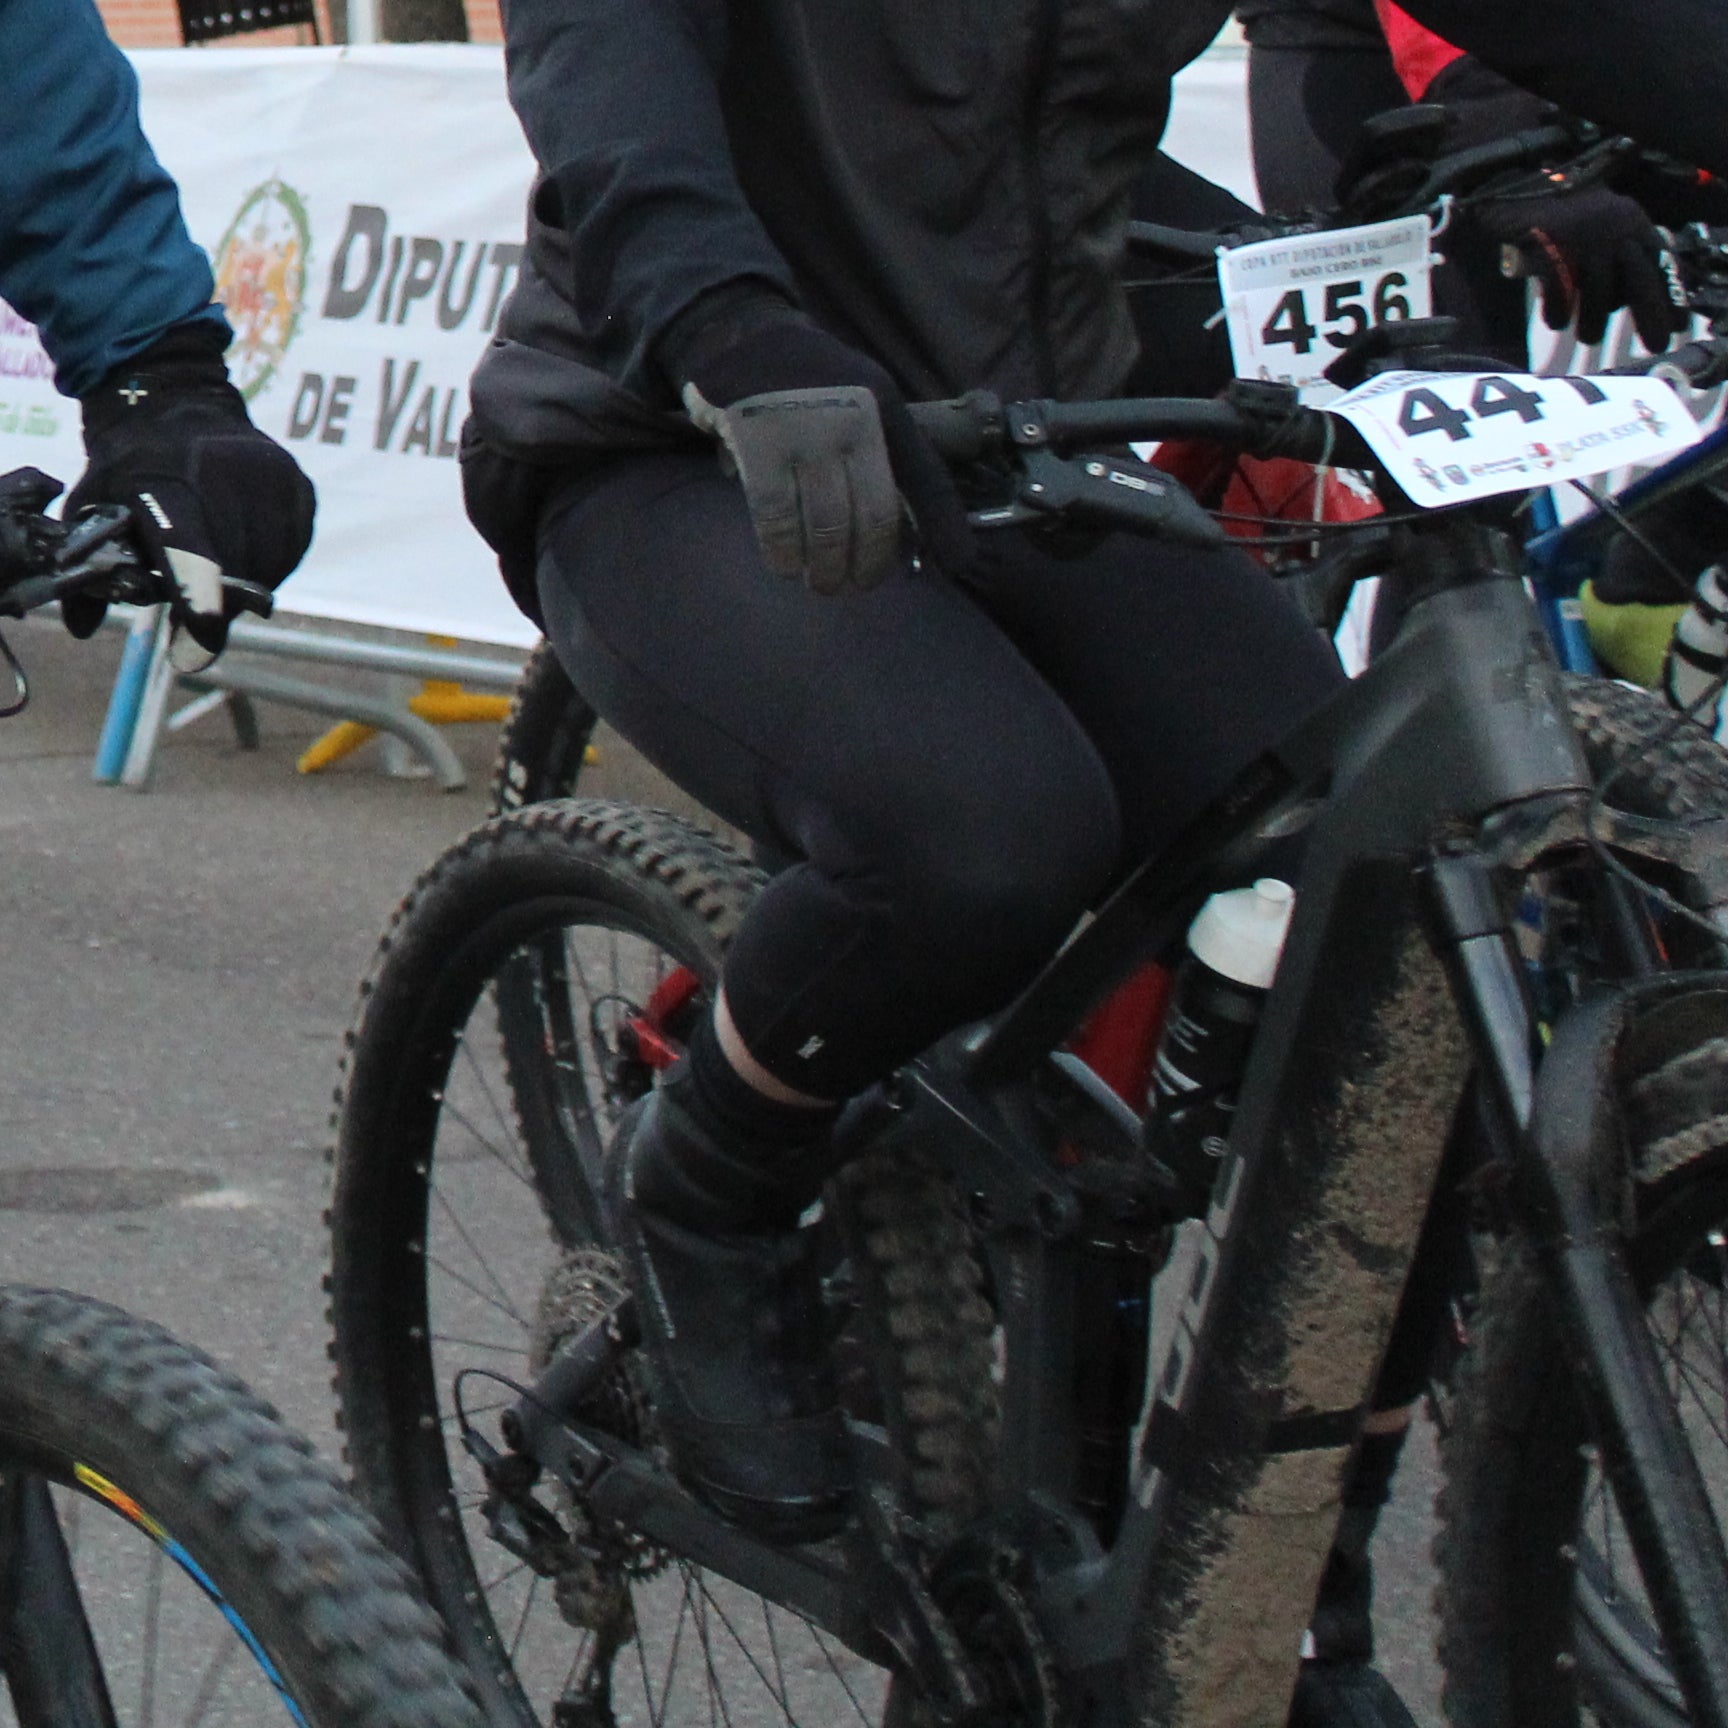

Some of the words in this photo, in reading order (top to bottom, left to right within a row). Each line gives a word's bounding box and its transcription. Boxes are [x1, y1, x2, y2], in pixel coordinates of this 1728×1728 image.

[322, 203, 525, 332] DIPUT
[1262, 272, 1410, 354] 456
[285, 372, 356, 446] DE
[372, 357, 459, 459] VAL
